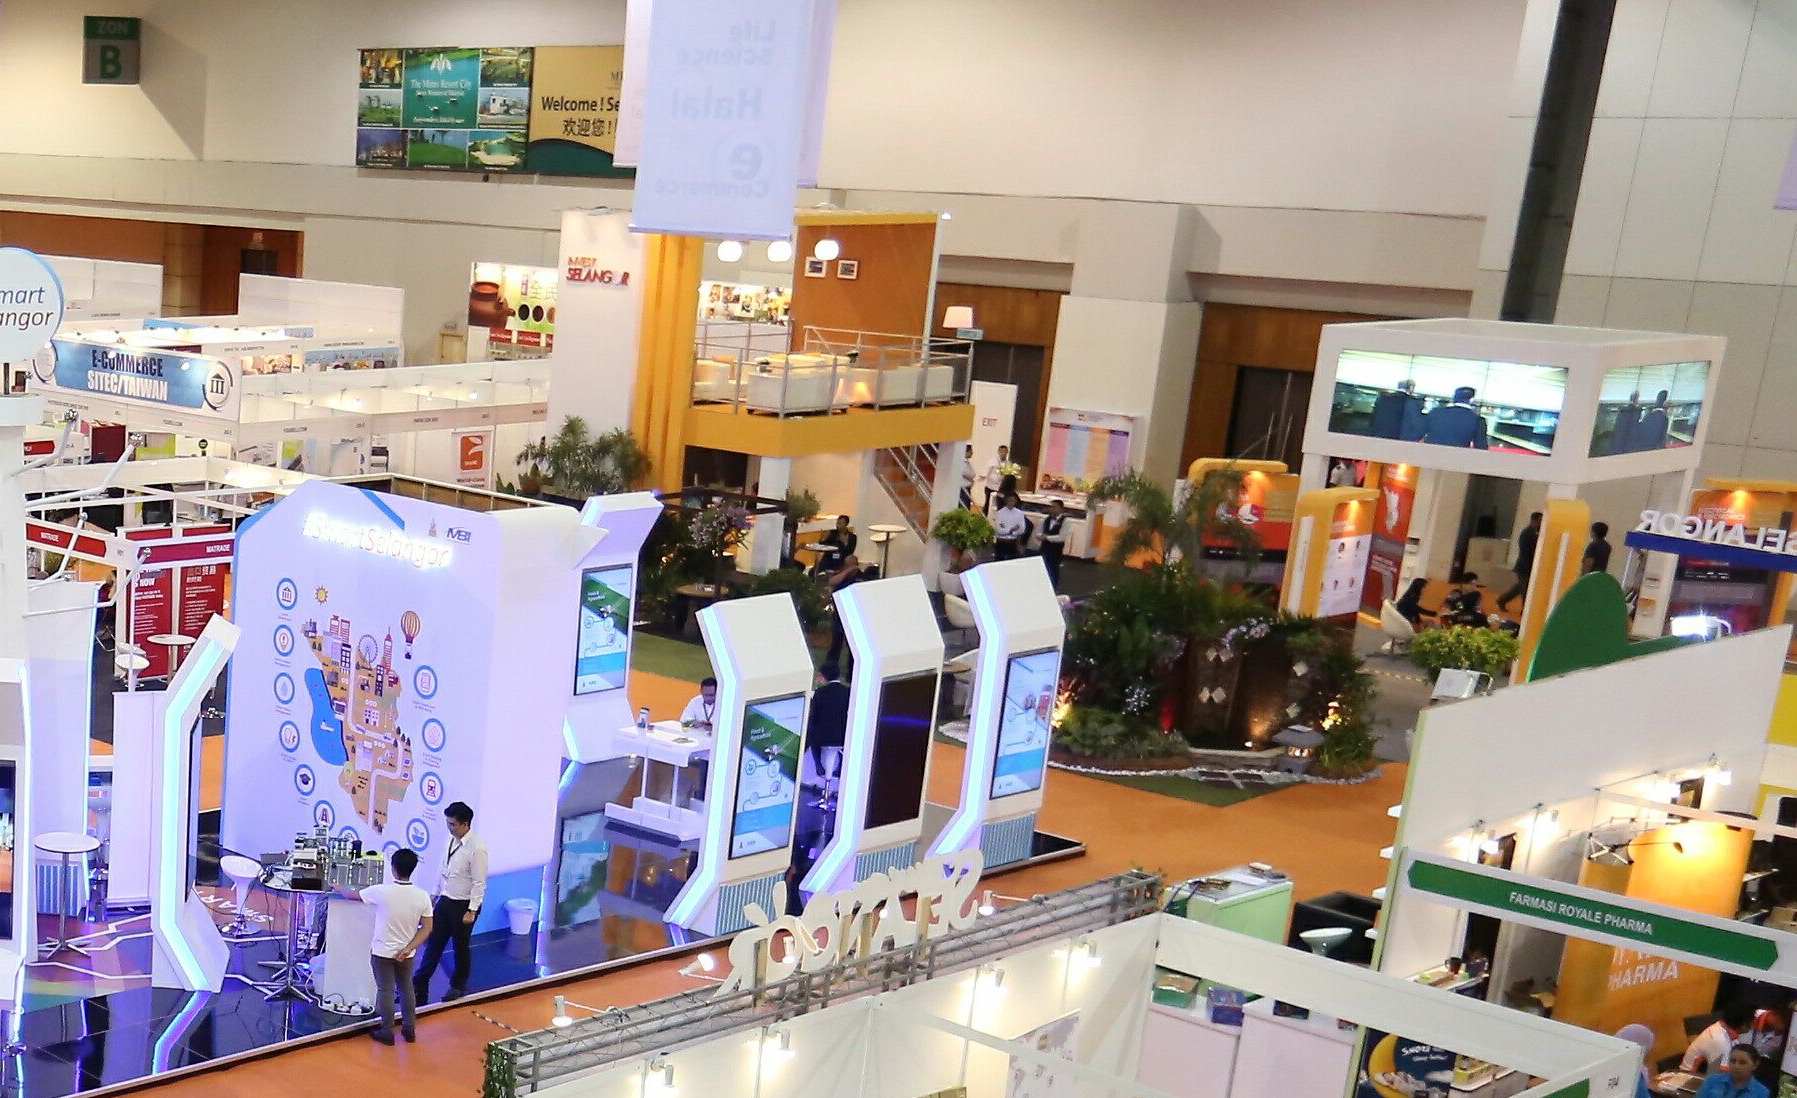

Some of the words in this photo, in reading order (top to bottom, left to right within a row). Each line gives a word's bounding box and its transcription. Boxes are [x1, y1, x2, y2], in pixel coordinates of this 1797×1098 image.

[98, 21, 128, 34] ZON
[100, 45, 122, 79] B
[91, 350, 164, 377] E-COMMERCE
[87, 370, 168, 401] SITEC/TAIWAN
[205, 543, 231, 554] MATRADE
[1509, 891, 1557, 916] FARMASI
[1558, 902, 1602, 925] ROYALE
[1604, 912, 1653, 935] PHARMA
